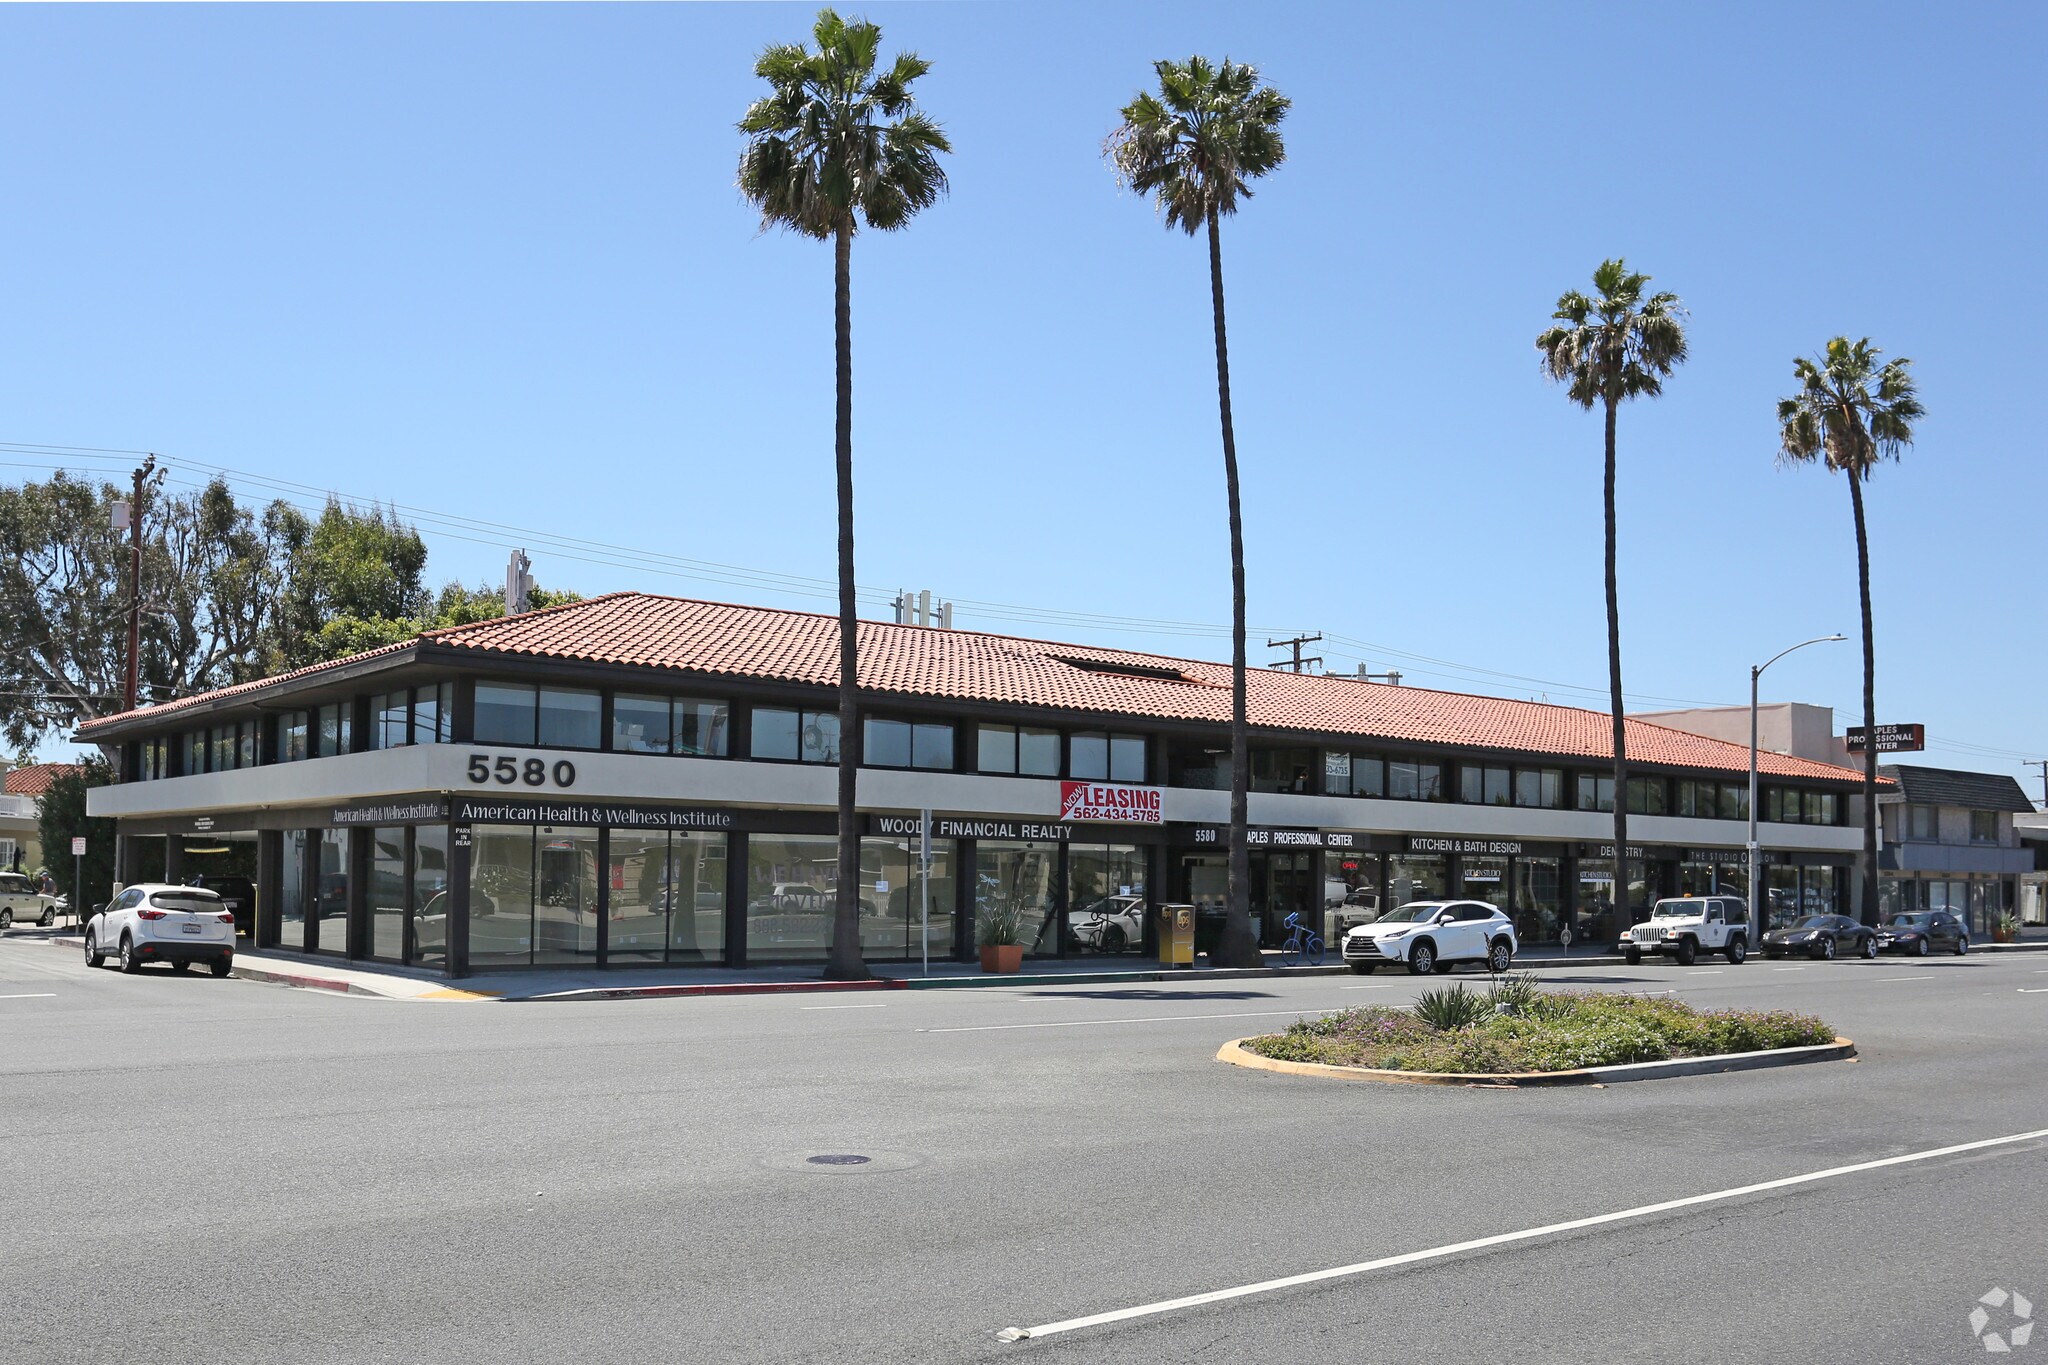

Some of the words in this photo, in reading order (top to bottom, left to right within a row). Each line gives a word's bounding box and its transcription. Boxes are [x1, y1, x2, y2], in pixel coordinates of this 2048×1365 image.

[1848, 733, 1913, 743] PROSSIONAL
[467, 754, 577, 788] 5580
[1063, 785, 1084, 811] NOW
[1083, 787, 1161, 810] LEASING
[334, 809, 359, 822] American
[360, 807, 378, 821] Health
[378, 806, 384, 820] &
[384, 805, 409, 820] Wellness
[410, 803, 438, 818] Institute
[461, 804, 536, 820] American
[540, 806, 588, 822] Health
[591, 808, 602, 823] &
[606, 809, 668, 825] Wellness
[670, 811, 730, 826] Institute
[1073, 807, 1161, 822] 562-434-5785
[940, 821, 1016, 837] FINANCIAL
[1021, 824, 1072, 839] REALTY
[1195, 829, 1216, 842] 5580
[1246, 831, 1268, 844] APLES
[1273, 832, 1322, 846] PROFESSIONAL
[1327, 834, 1353, 846] CENTER
[1411, 838, 1452, 851] KITCHEN
[1454, 840, 1462, 851] &
[1464, 841, 1487, 853] BATH
[1489, 842, 1521, 853] DESIGN
[1691, 851, 1705, 861] THE
[1710, 852, 1738, 862] STUDIO
[1179, 915, 1189, 926] ups
